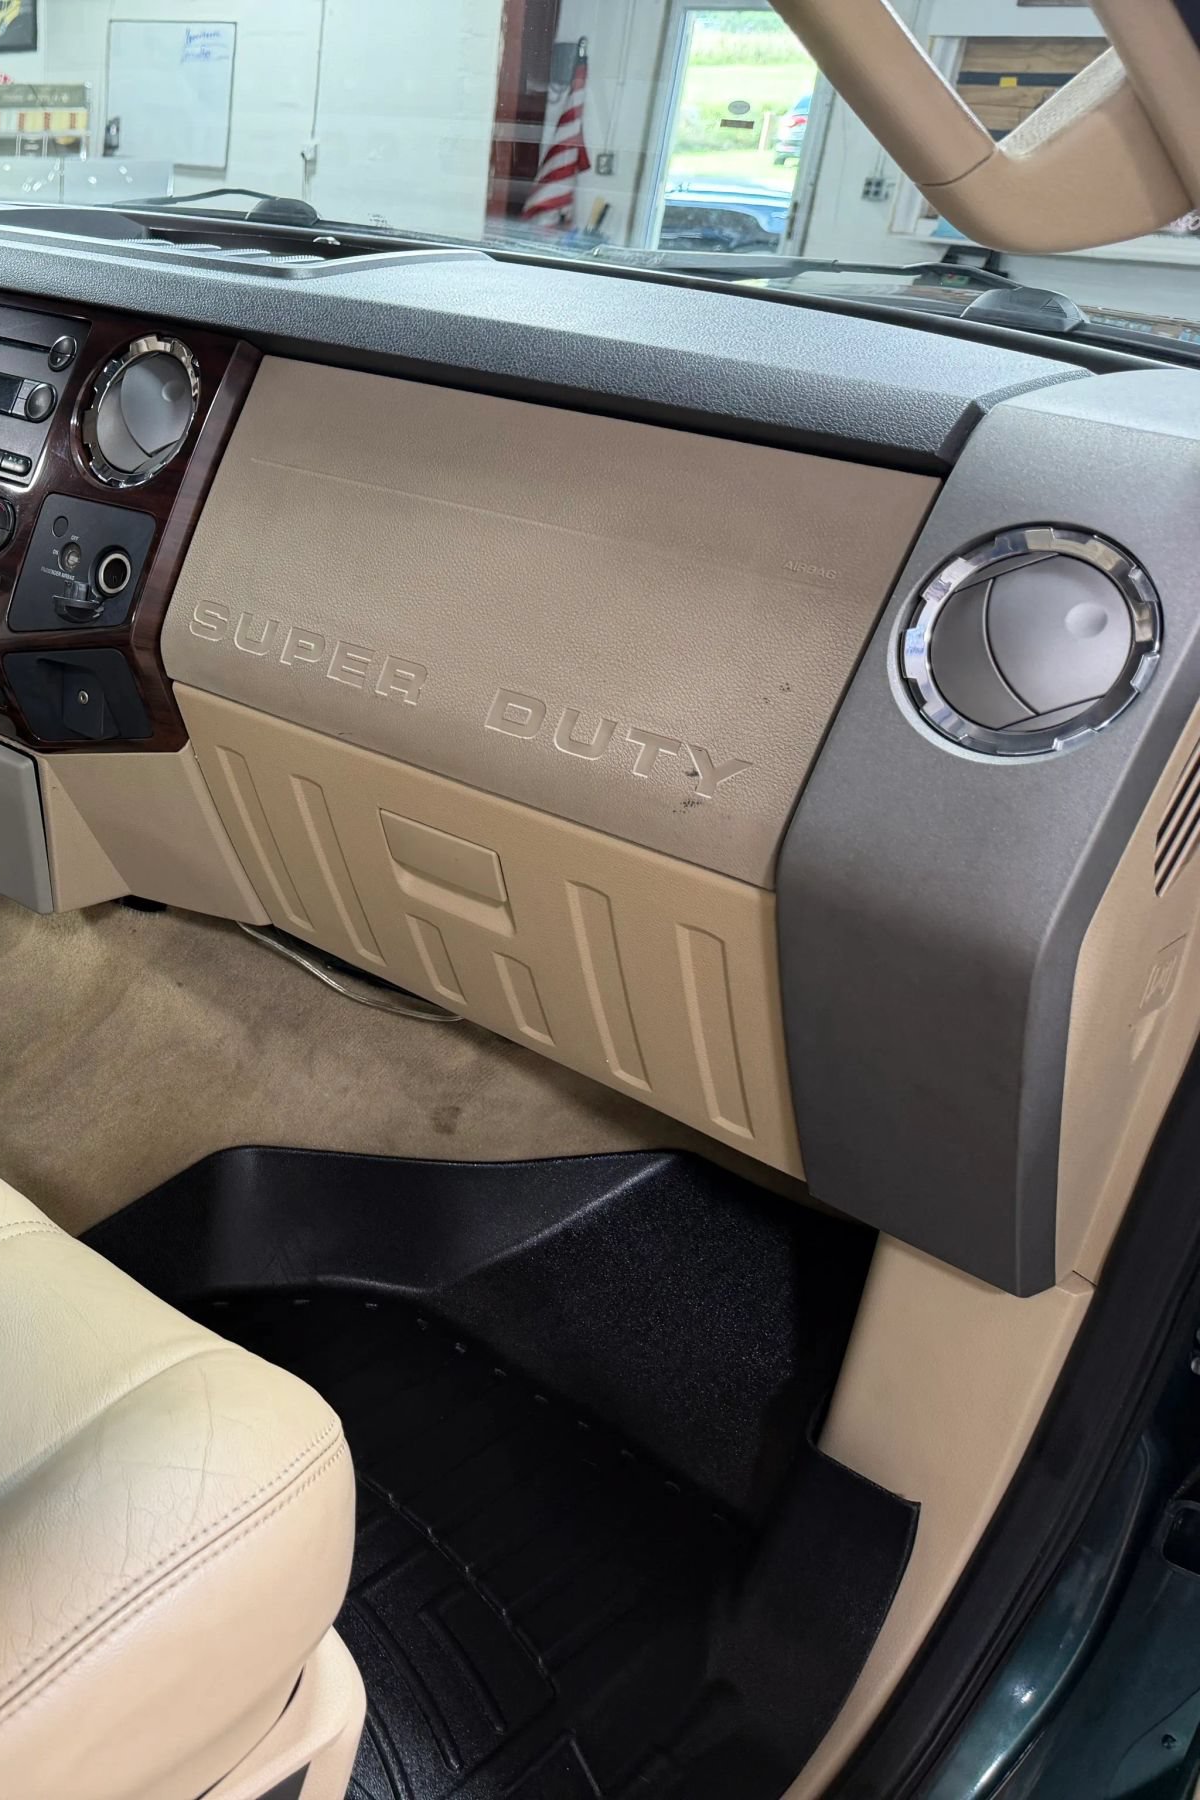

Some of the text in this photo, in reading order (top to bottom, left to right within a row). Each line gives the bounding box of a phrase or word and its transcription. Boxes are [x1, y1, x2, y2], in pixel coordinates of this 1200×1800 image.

[783, 560, 837, 580] AIRBAG
[189, 600, 753, 799] SUPER DUTY
